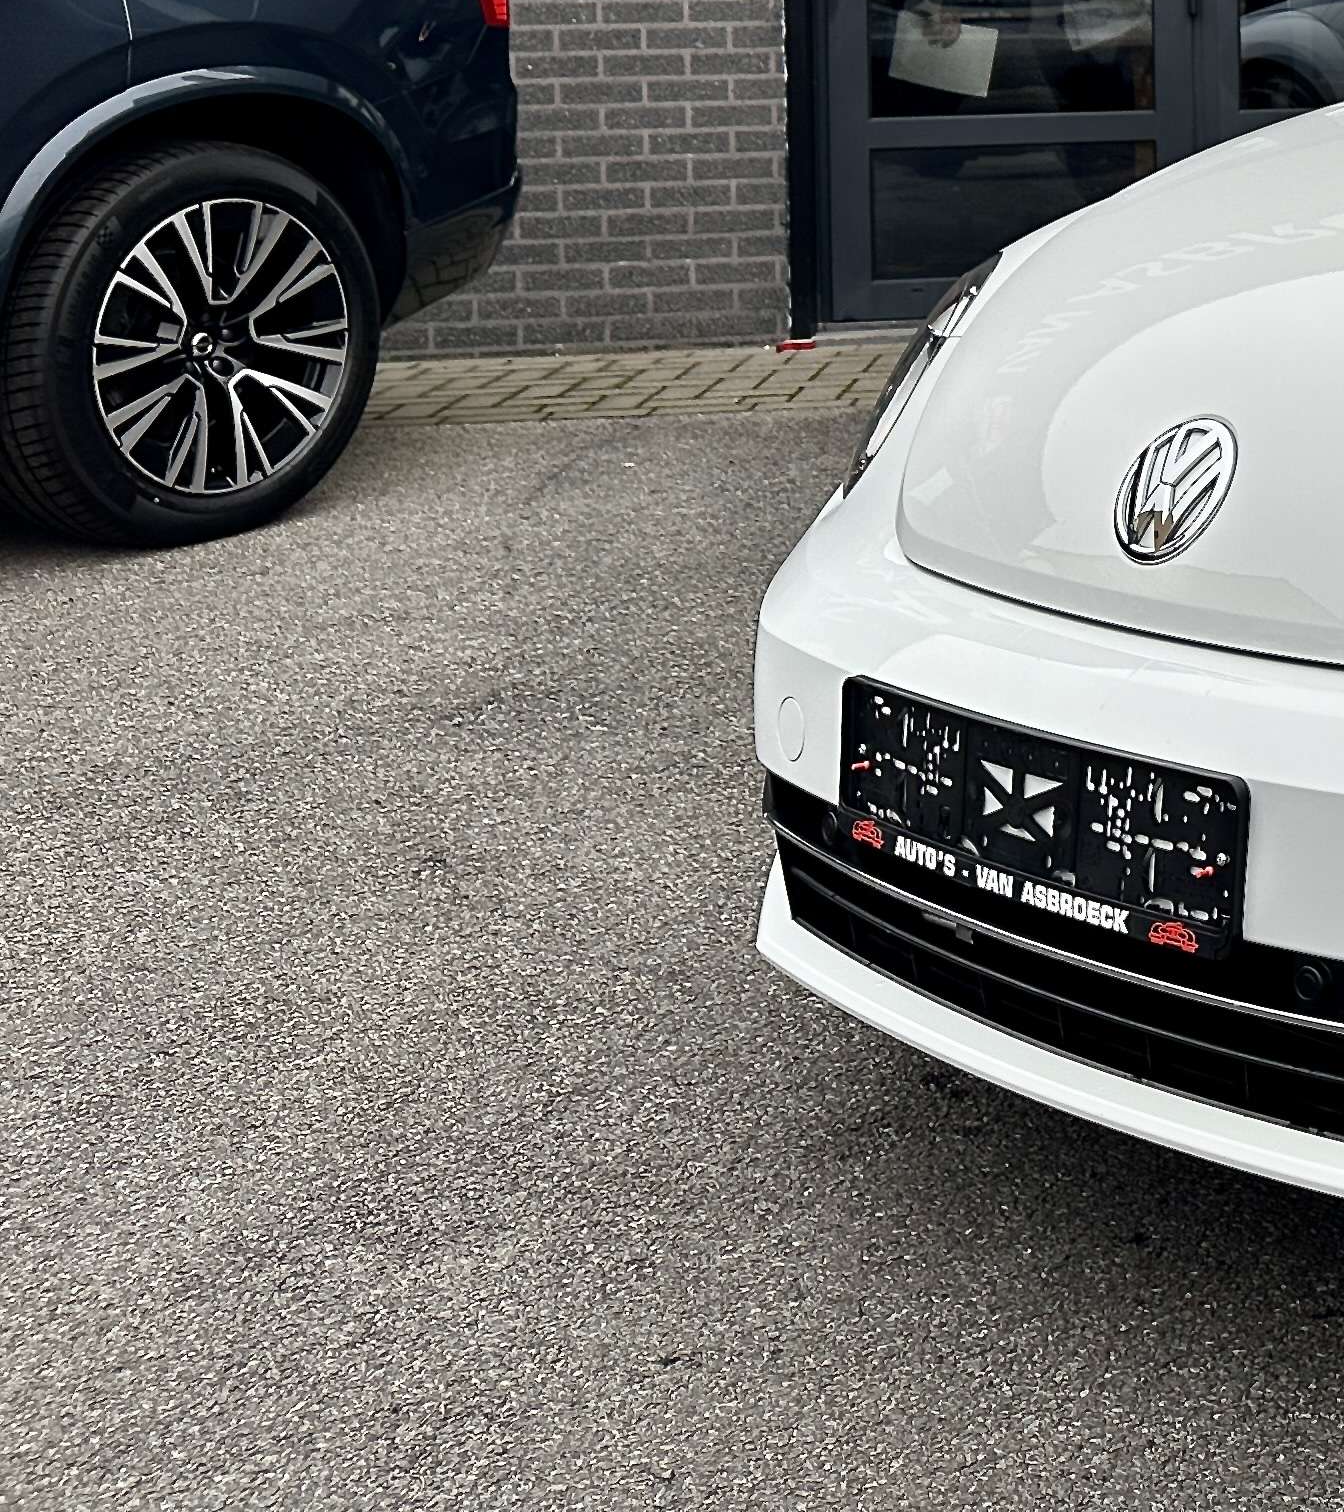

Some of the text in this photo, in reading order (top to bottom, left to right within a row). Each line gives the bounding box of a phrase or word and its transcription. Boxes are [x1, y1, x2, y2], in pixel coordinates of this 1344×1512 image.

[894, 835, 957, 877] AUTO'S
[975, 864, 1014, 899] VAN
[1020, 880, 1130, 935] ASBROECK
